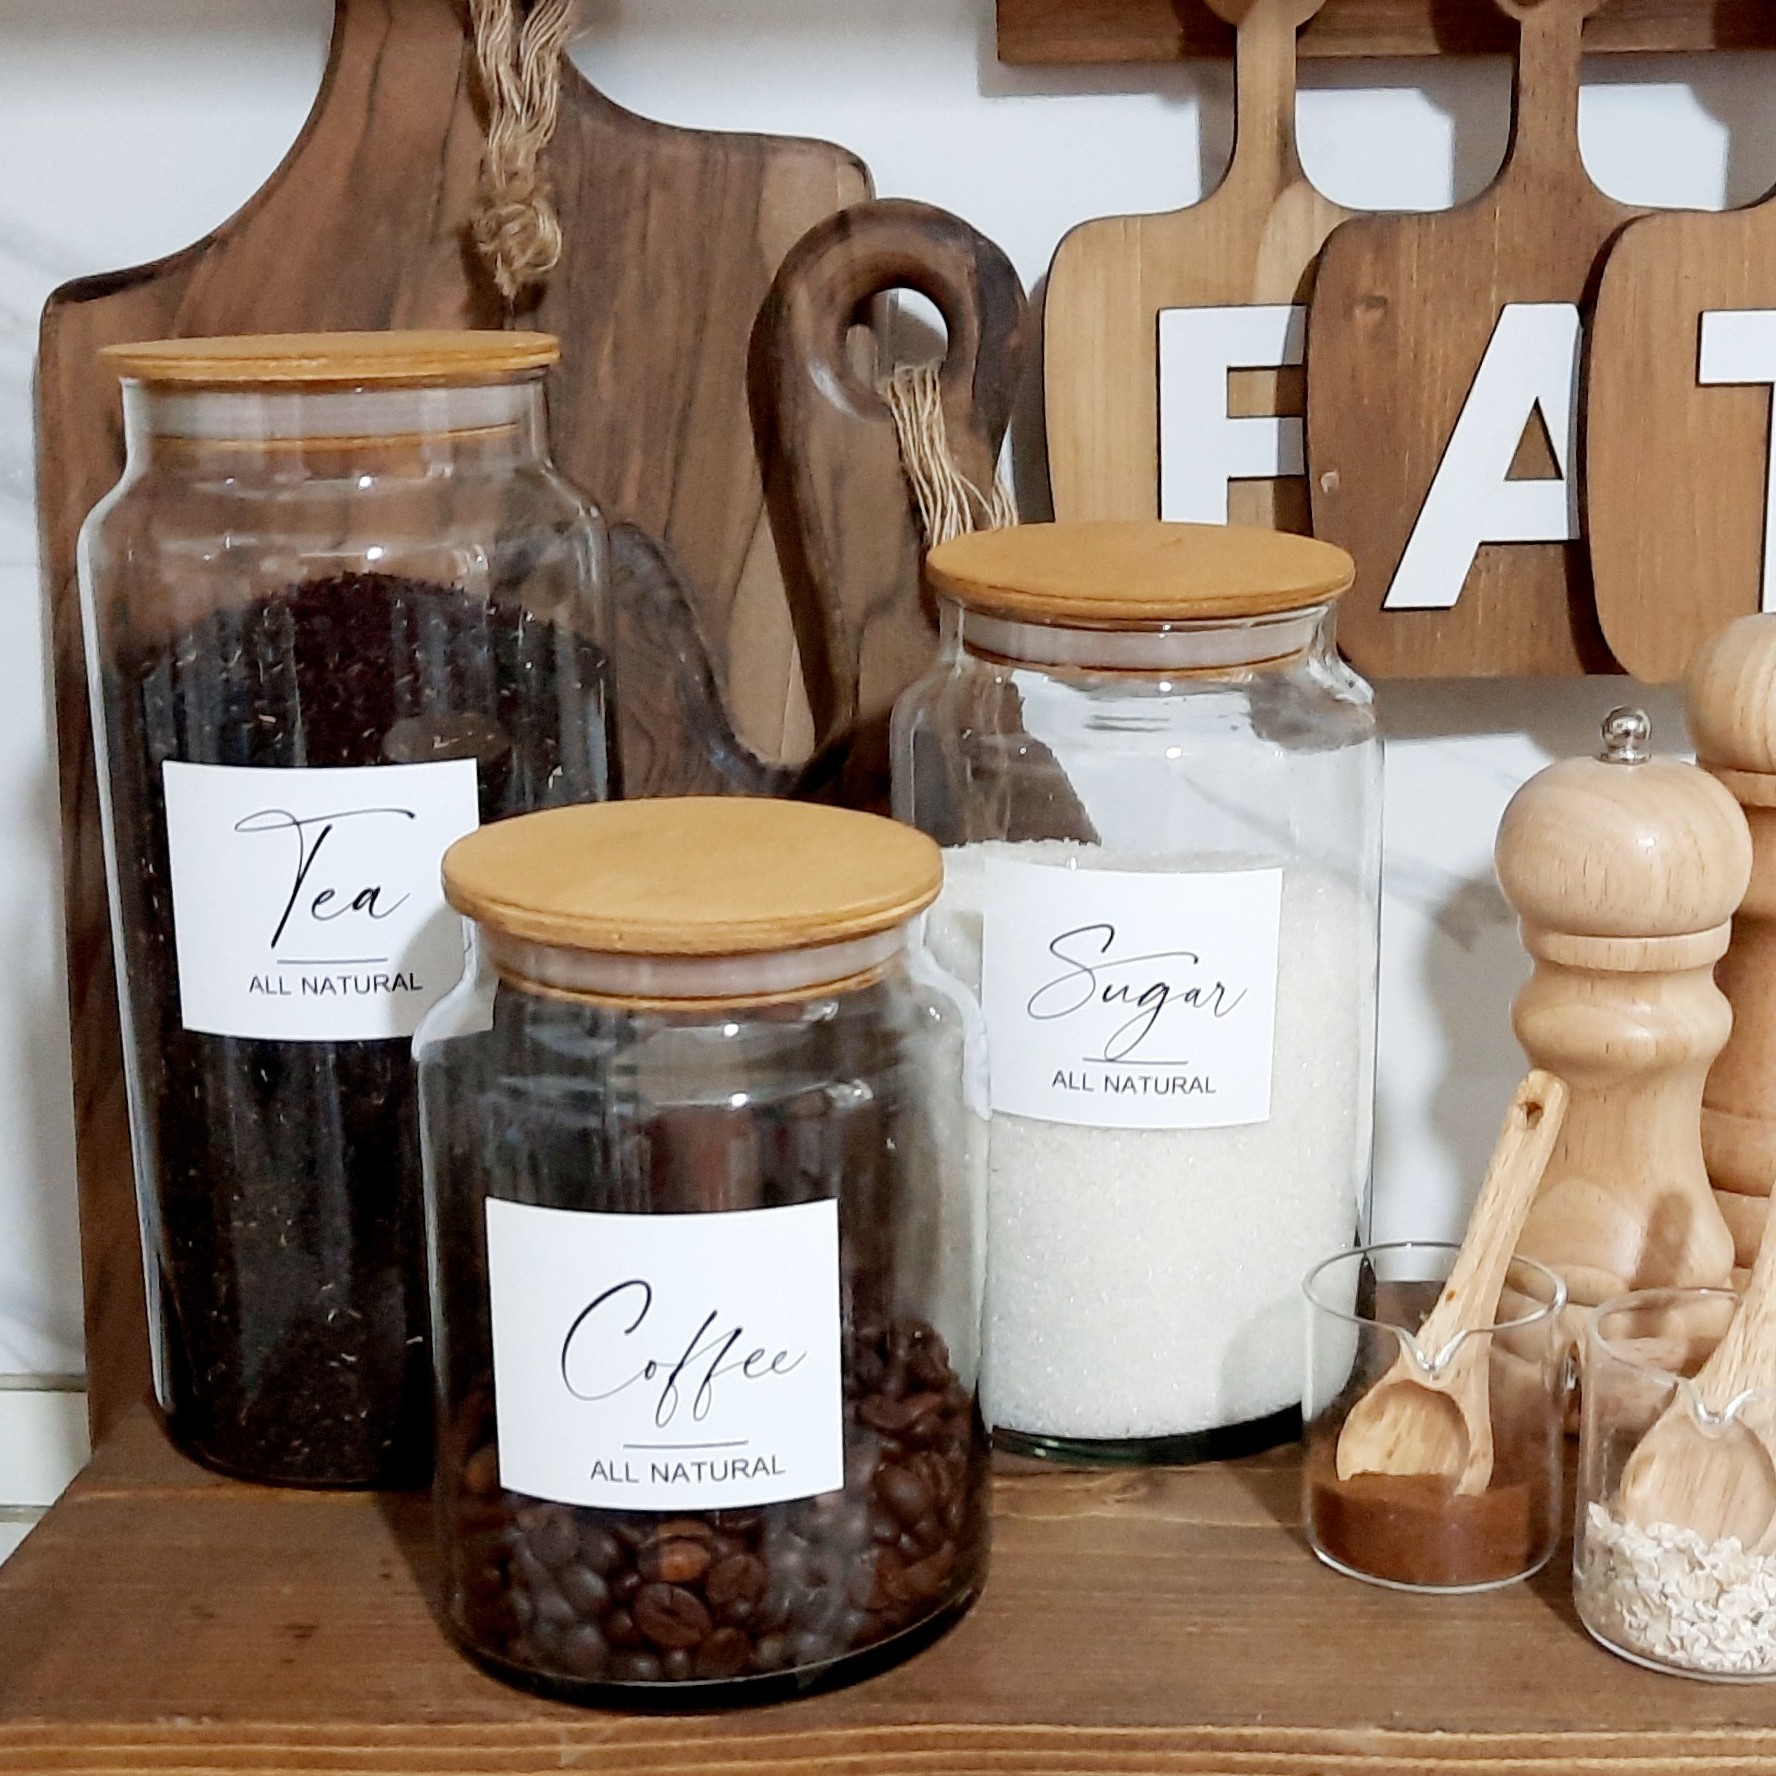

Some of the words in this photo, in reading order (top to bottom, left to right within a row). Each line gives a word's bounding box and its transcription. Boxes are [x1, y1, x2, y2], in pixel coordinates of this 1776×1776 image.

[235, 808, 417, 950] Tea
[249, 975, 292, 996] ALL
[301, 972, 424, 996] NATURAL
[1027, 923, 1249, 1062] Sugar
[1052, 1069, 1096, 1091] ALL
[1103, 1074, 1217, 1096] NATURAL
[561, 1279, 807, 1428] Coffee
[590, 1460, 640, 1485] ALL
[650, 1454, 787, 1484] NATURAL
